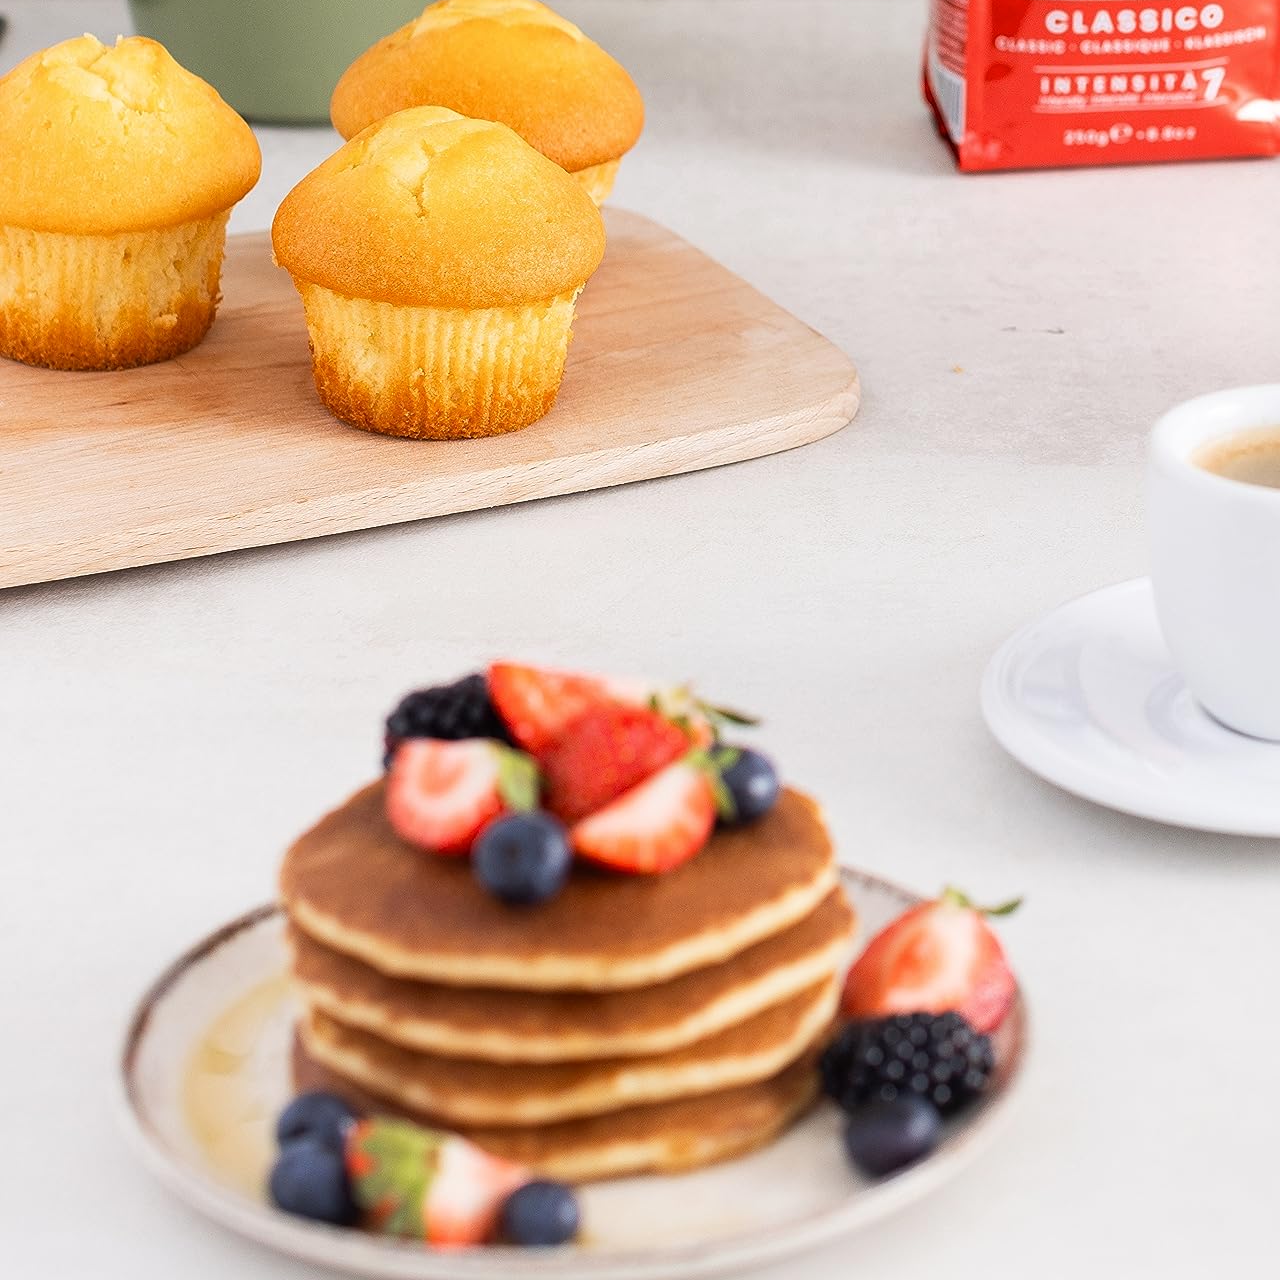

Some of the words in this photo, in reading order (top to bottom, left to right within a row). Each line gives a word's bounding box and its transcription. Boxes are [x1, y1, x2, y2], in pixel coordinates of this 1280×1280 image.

[1045, 4, 1225, 35] CLASSICO
[995, 35, 1066, 55] CLASSIC
[1080, 38, 1170, 55] CLASSIQUE
[1201, 66, 1226, 101] 7
